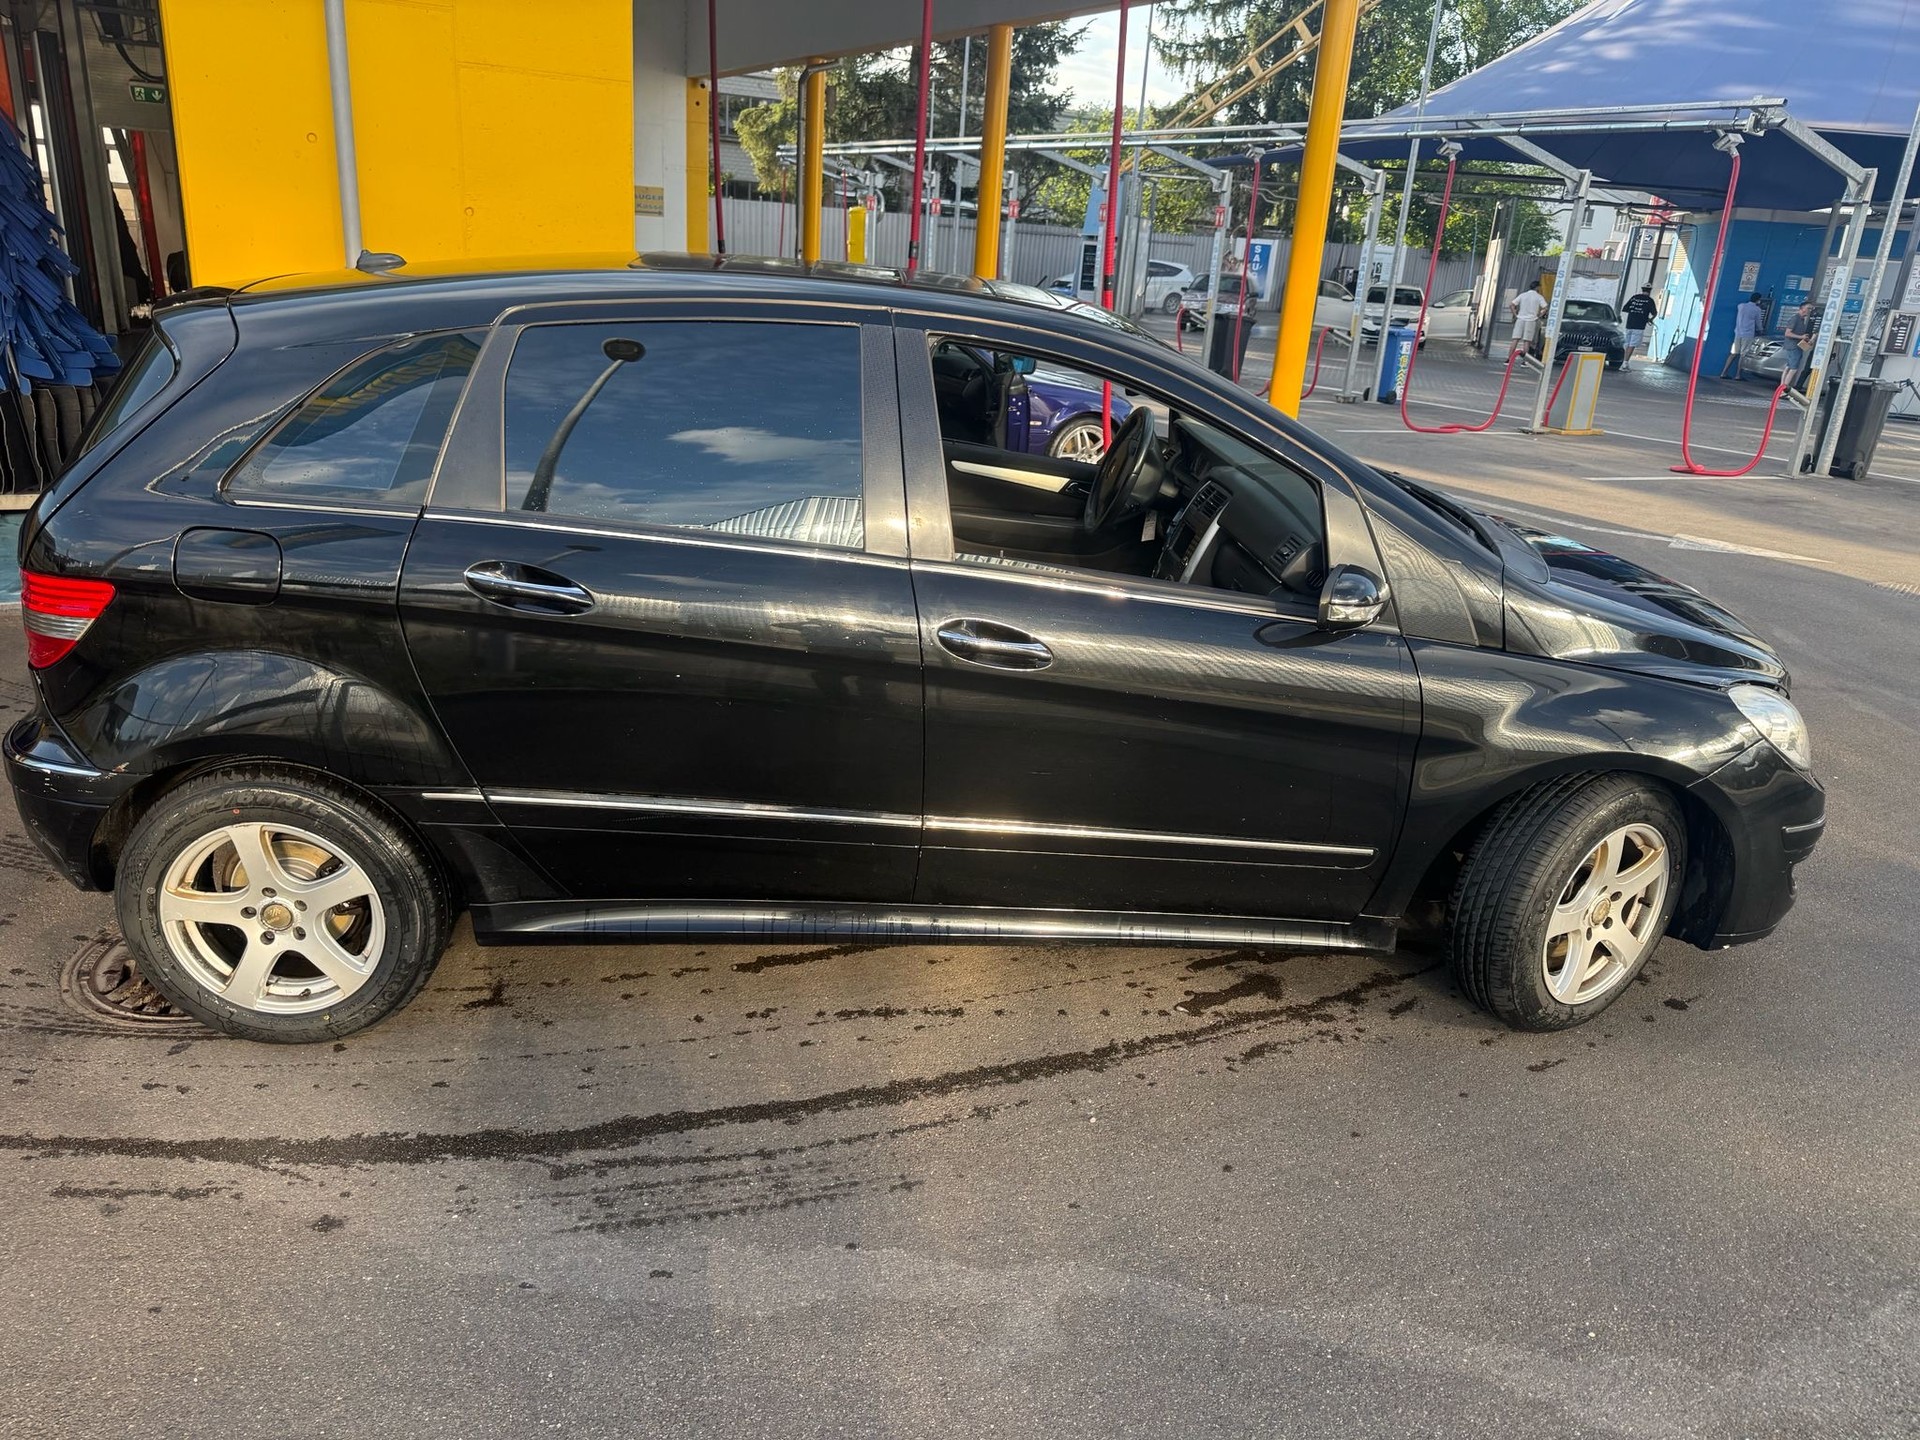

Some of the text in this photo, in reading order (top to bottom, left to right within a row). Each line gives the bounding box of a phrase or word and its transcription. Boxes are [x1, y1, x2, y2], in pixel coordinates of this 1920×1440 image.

[1548, 270, 1565, 328] SAUGER
[1836, 277, 1843, 285] 8
[1815, 288, 1842, 356] SAUGER
